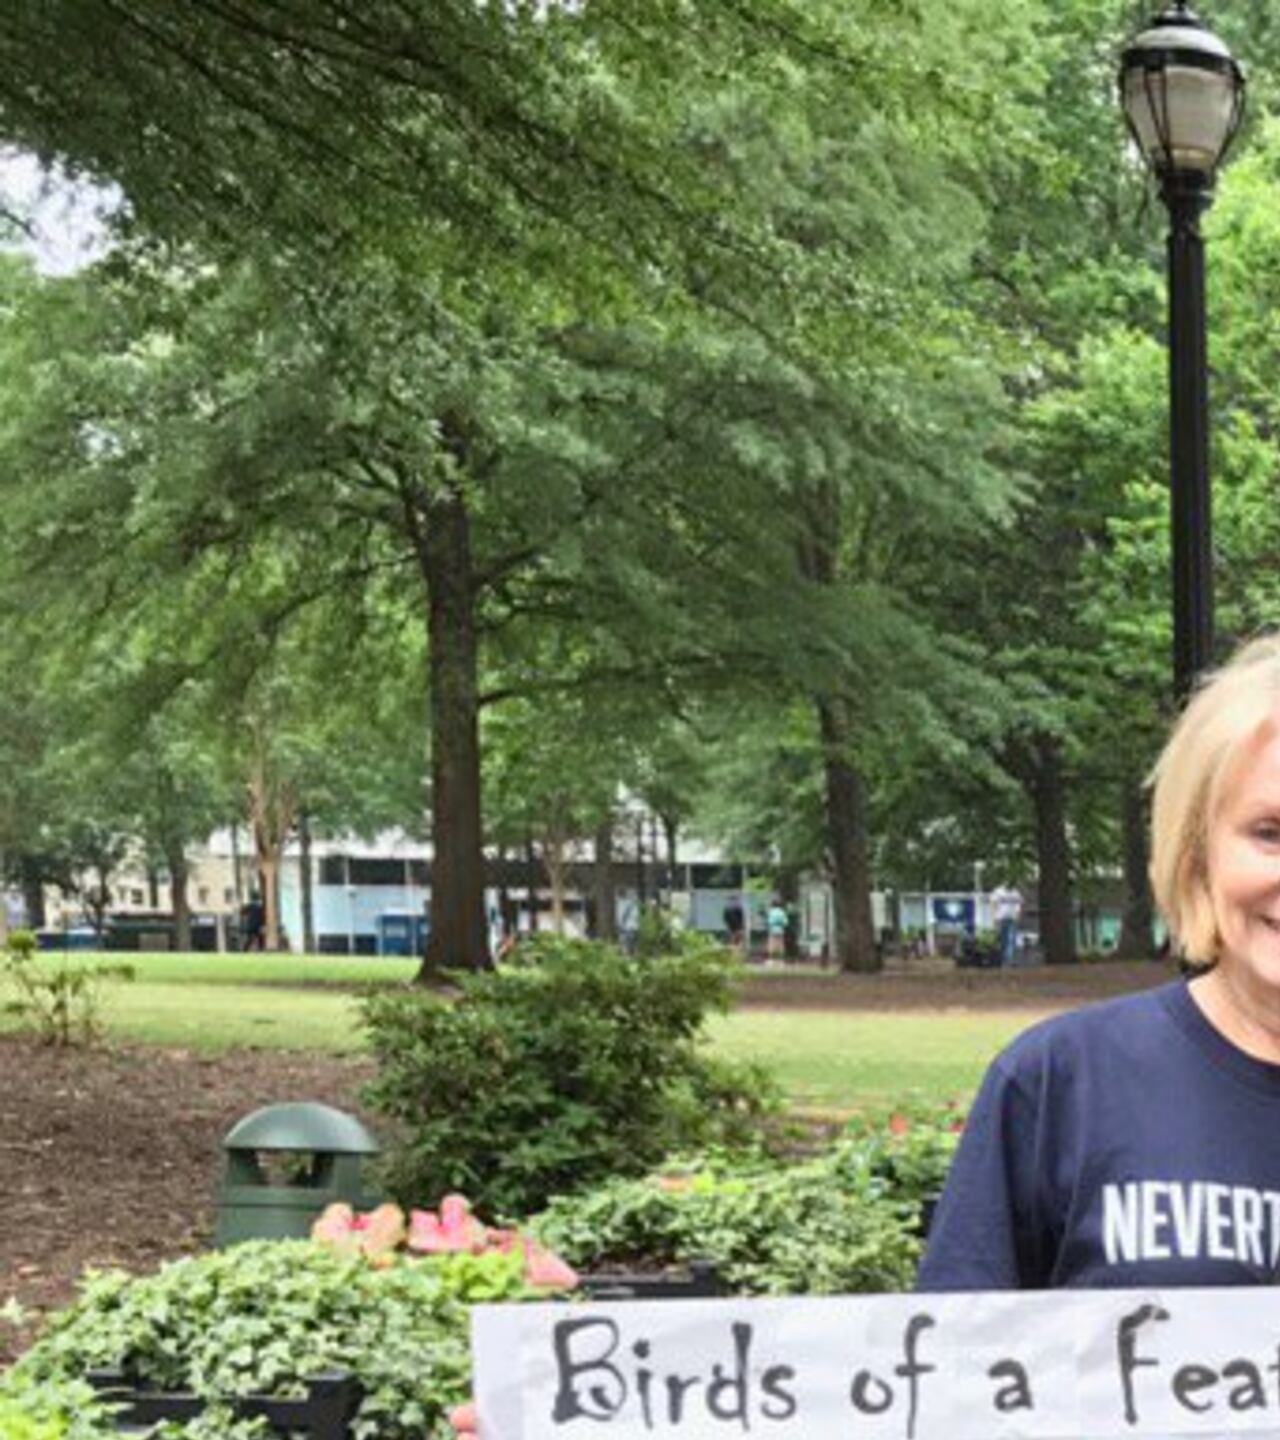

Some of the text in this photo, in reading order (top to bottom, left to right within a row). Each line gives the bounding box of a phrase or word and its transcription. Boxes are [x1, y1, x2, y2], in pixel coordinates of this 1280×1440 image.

[551, 1316, 799, 1432] Birds
[850, 1313, 935, 1440] of
[986, 1358, 1035, 1412] a
